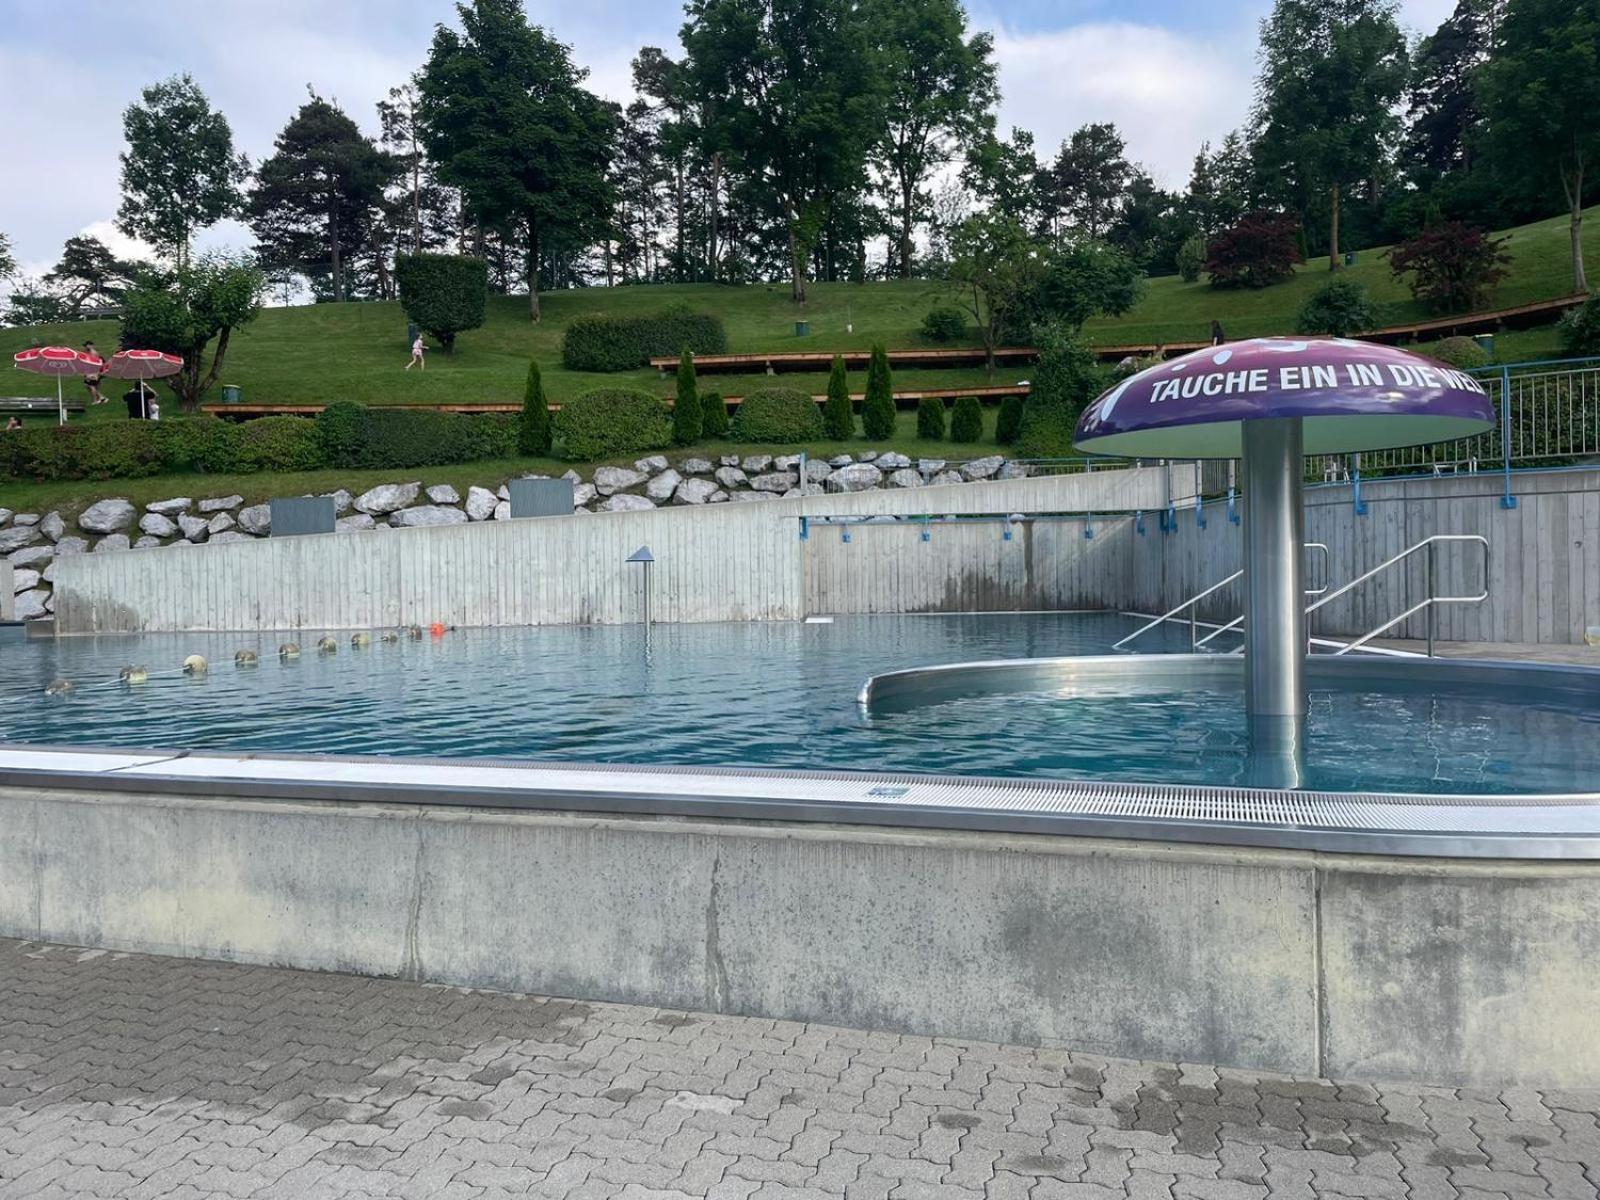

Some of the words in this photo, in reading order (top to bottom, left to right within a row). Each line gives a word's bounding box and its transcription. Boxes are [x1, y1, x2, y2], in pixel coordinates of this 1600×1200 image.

[1150, 369, 1268, 403] TAUCHE
[1280, 365, 1338, 389] EIN
[1346, 364, 1384, 386] IN
[1388, 364, 1441, 388] DIE
[1433, 366, 1486, 395] WEL
